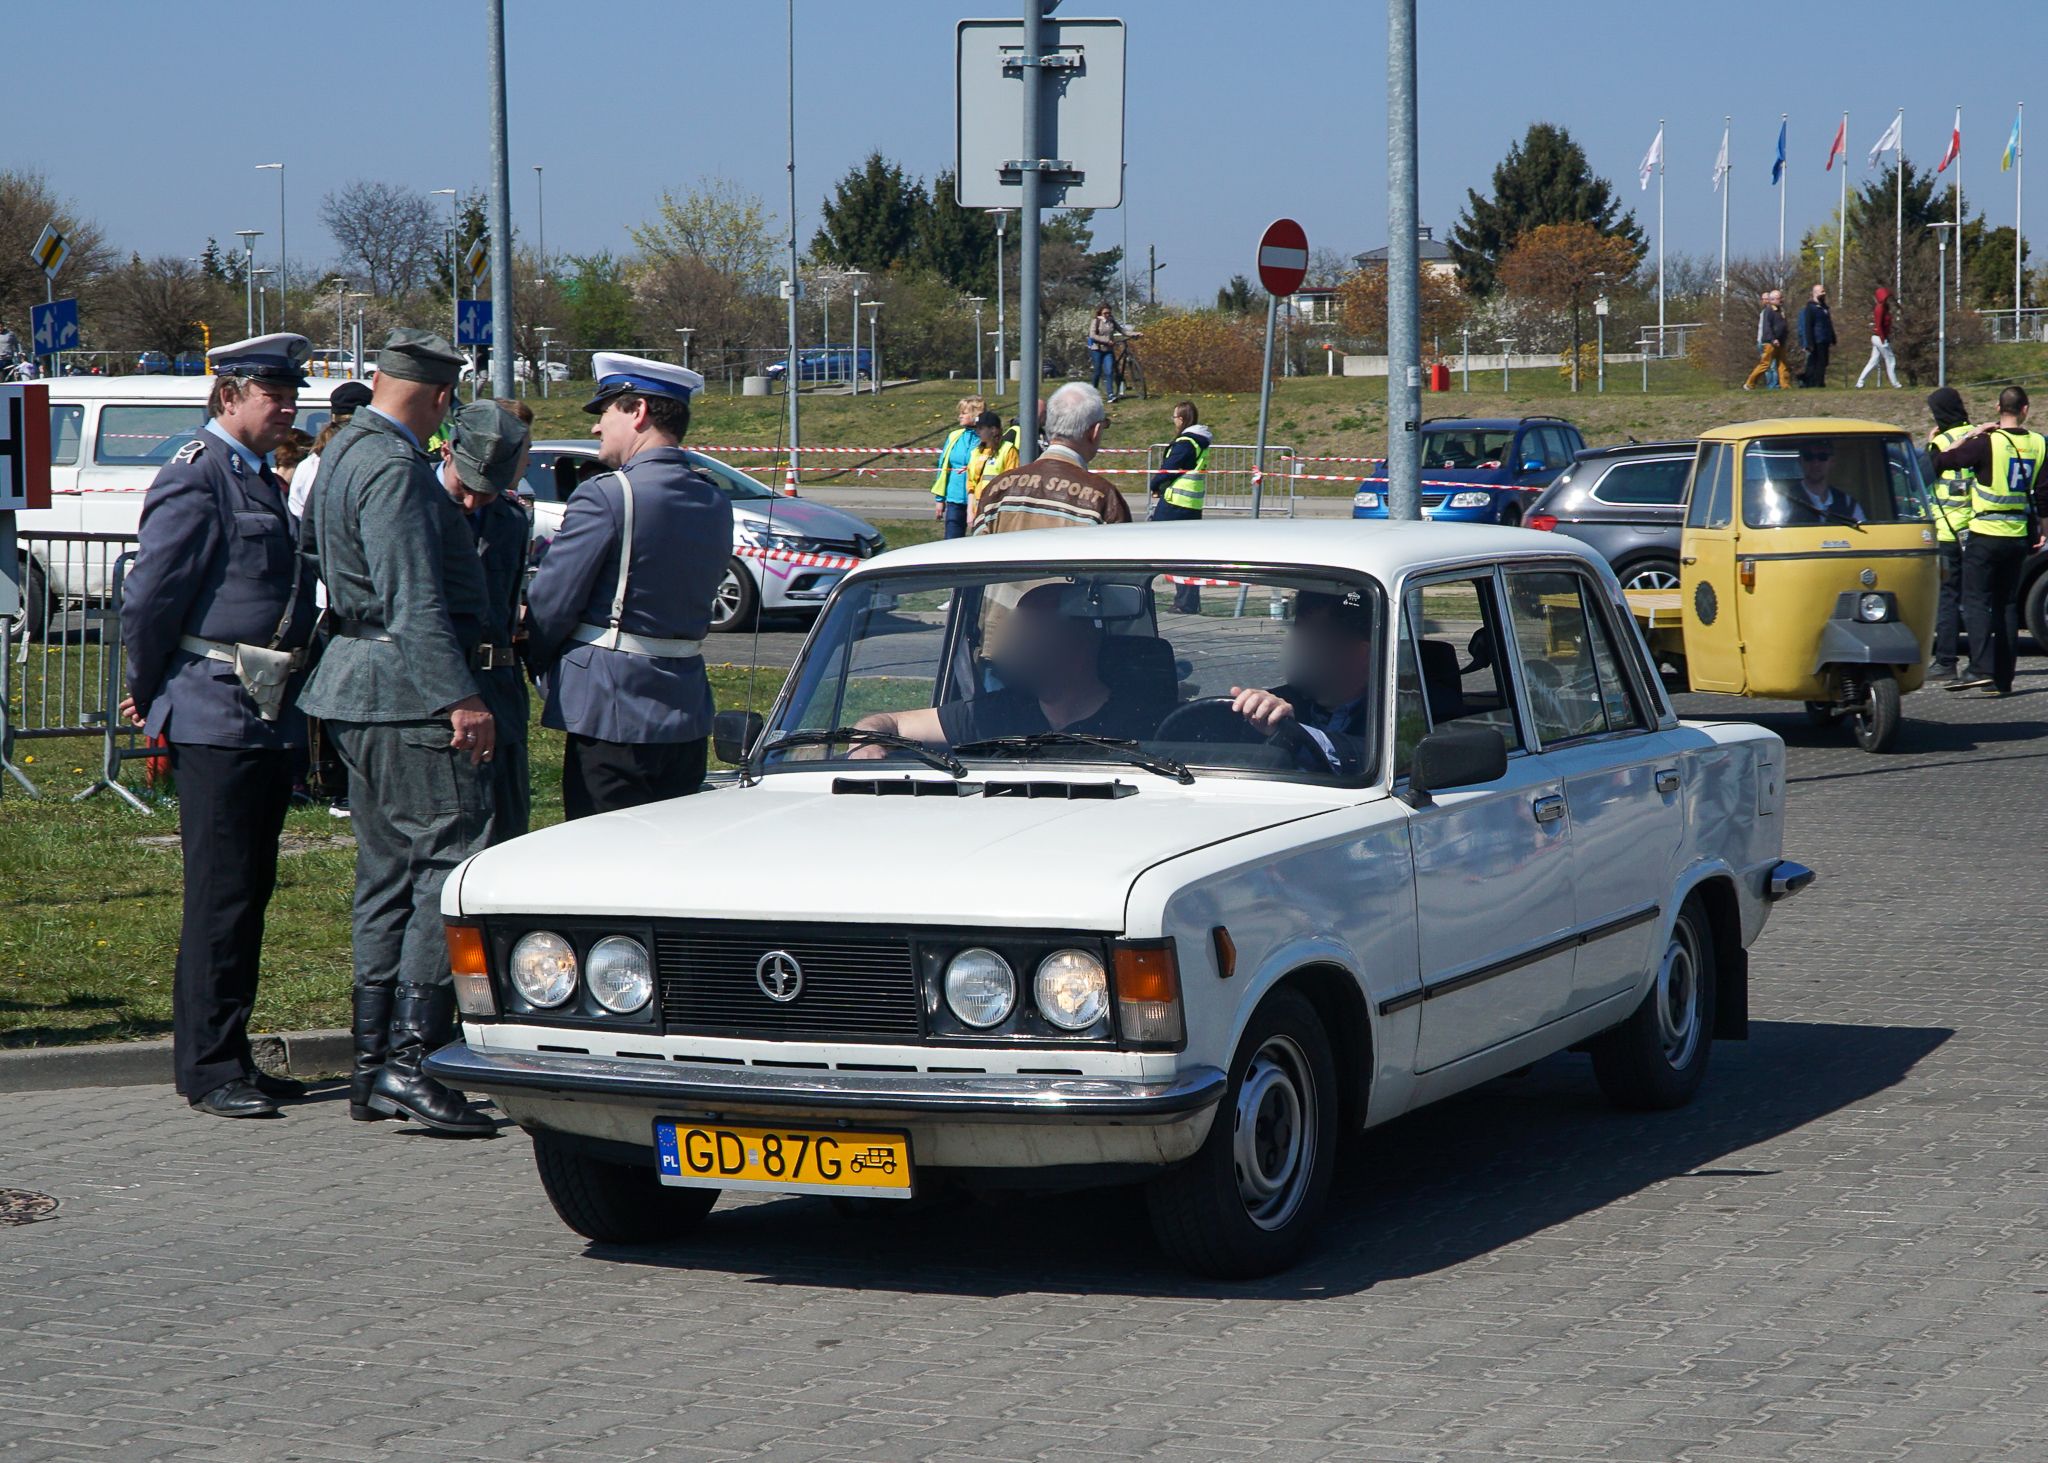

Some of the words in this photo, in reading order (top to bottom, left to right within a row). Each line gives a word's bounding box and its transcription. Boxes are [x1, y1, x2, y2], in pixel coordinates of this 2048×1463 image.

[2010, 462, 2032, 488] P
[1045, 477, 1105, 503] SPORT
[663, 1155, 678, 1168] PL
[685, 1129, 746, 1175] GD
[762, 1133, 842, 1180] 87G
